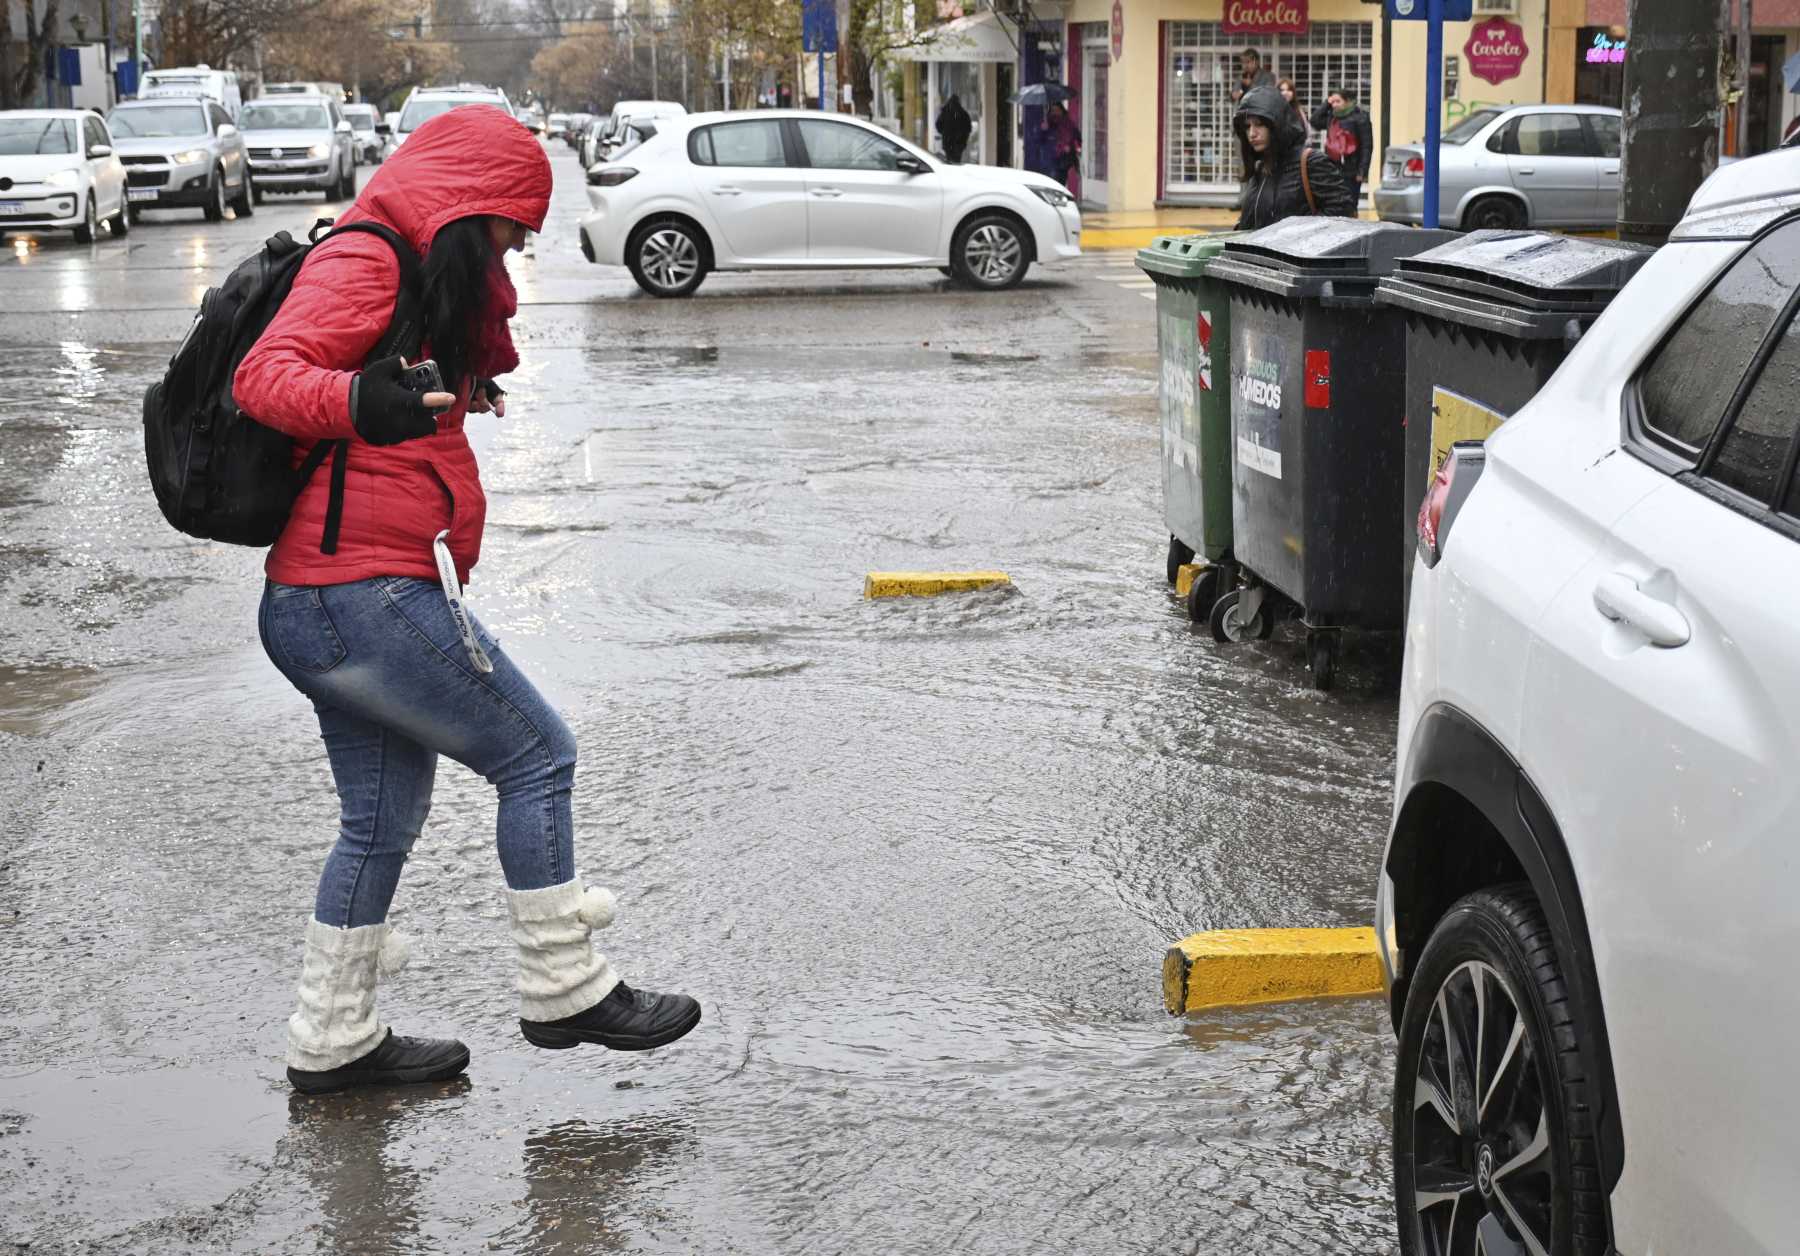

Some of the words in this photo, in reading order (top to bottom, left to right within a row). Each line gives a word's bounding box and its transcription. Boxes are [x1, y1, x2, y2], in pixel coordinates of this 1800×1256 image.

[1229, 1, 1301, 26] Carola
[1471, 40, 1521, 57] Carola
[455, 610, 468, 637] UPCN
